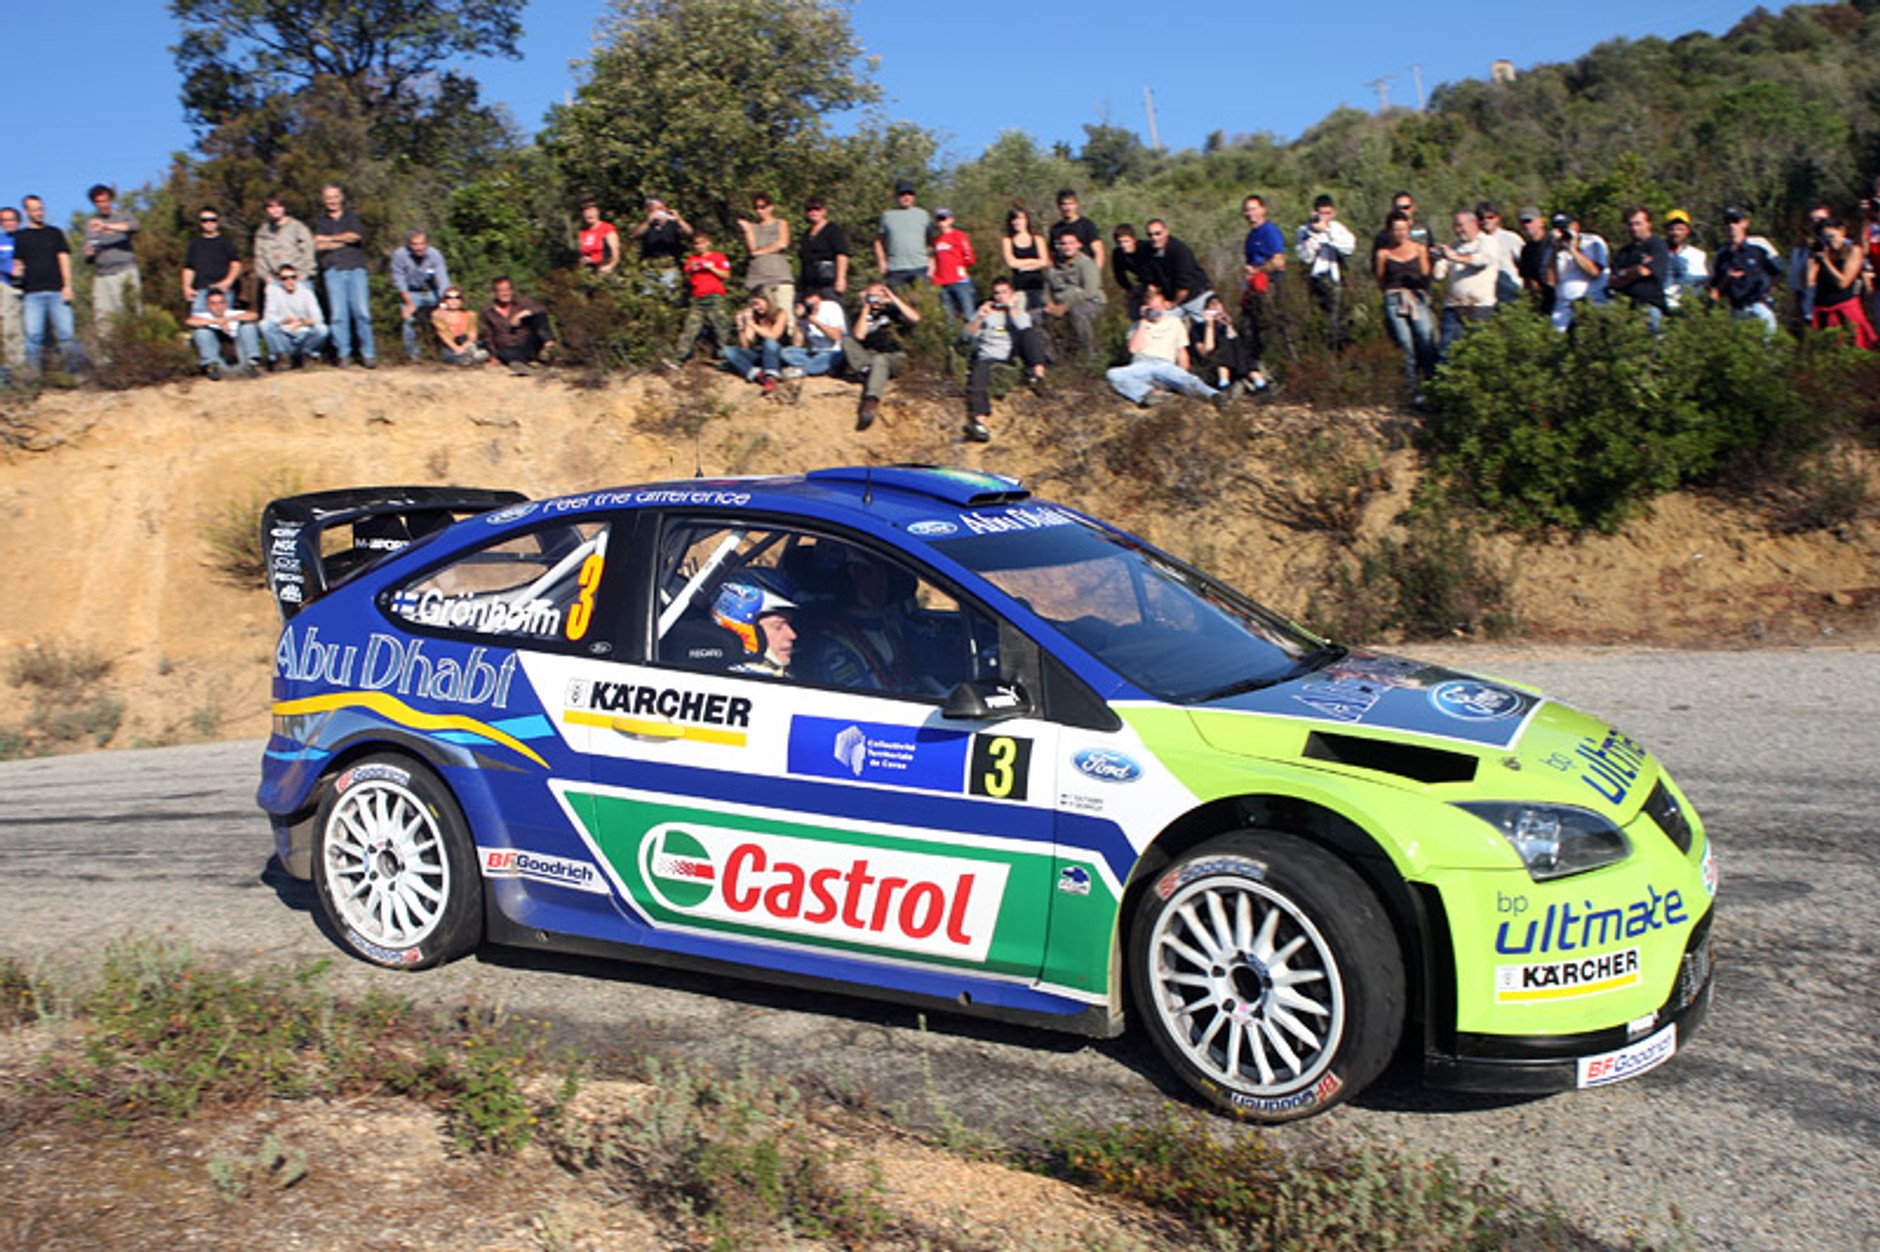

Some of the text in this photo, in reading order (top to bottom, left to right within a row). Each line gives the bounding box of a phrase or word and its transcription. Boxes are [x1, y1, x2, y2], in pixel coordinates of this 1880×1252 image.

[565, 552, 606, 642] 3
[274, 624, 517, 709] Abu Dhabi
[589, 680, 754, 728] KÄRCHER
[983, 737, 1018, 799] 3
[1081, 752, 1133, 780] Ford
[486, 852, 594, 881] BFGoodrich
[721, 842, 976, 946] Castrol
[1496, 890, 1529, 917] bp
[1494, 883, 1690, 955] ultimate
[1522, 949, 1638, 989] KÄRCHER
[1586, 1032, 1673, 1080] BFGoodrich
